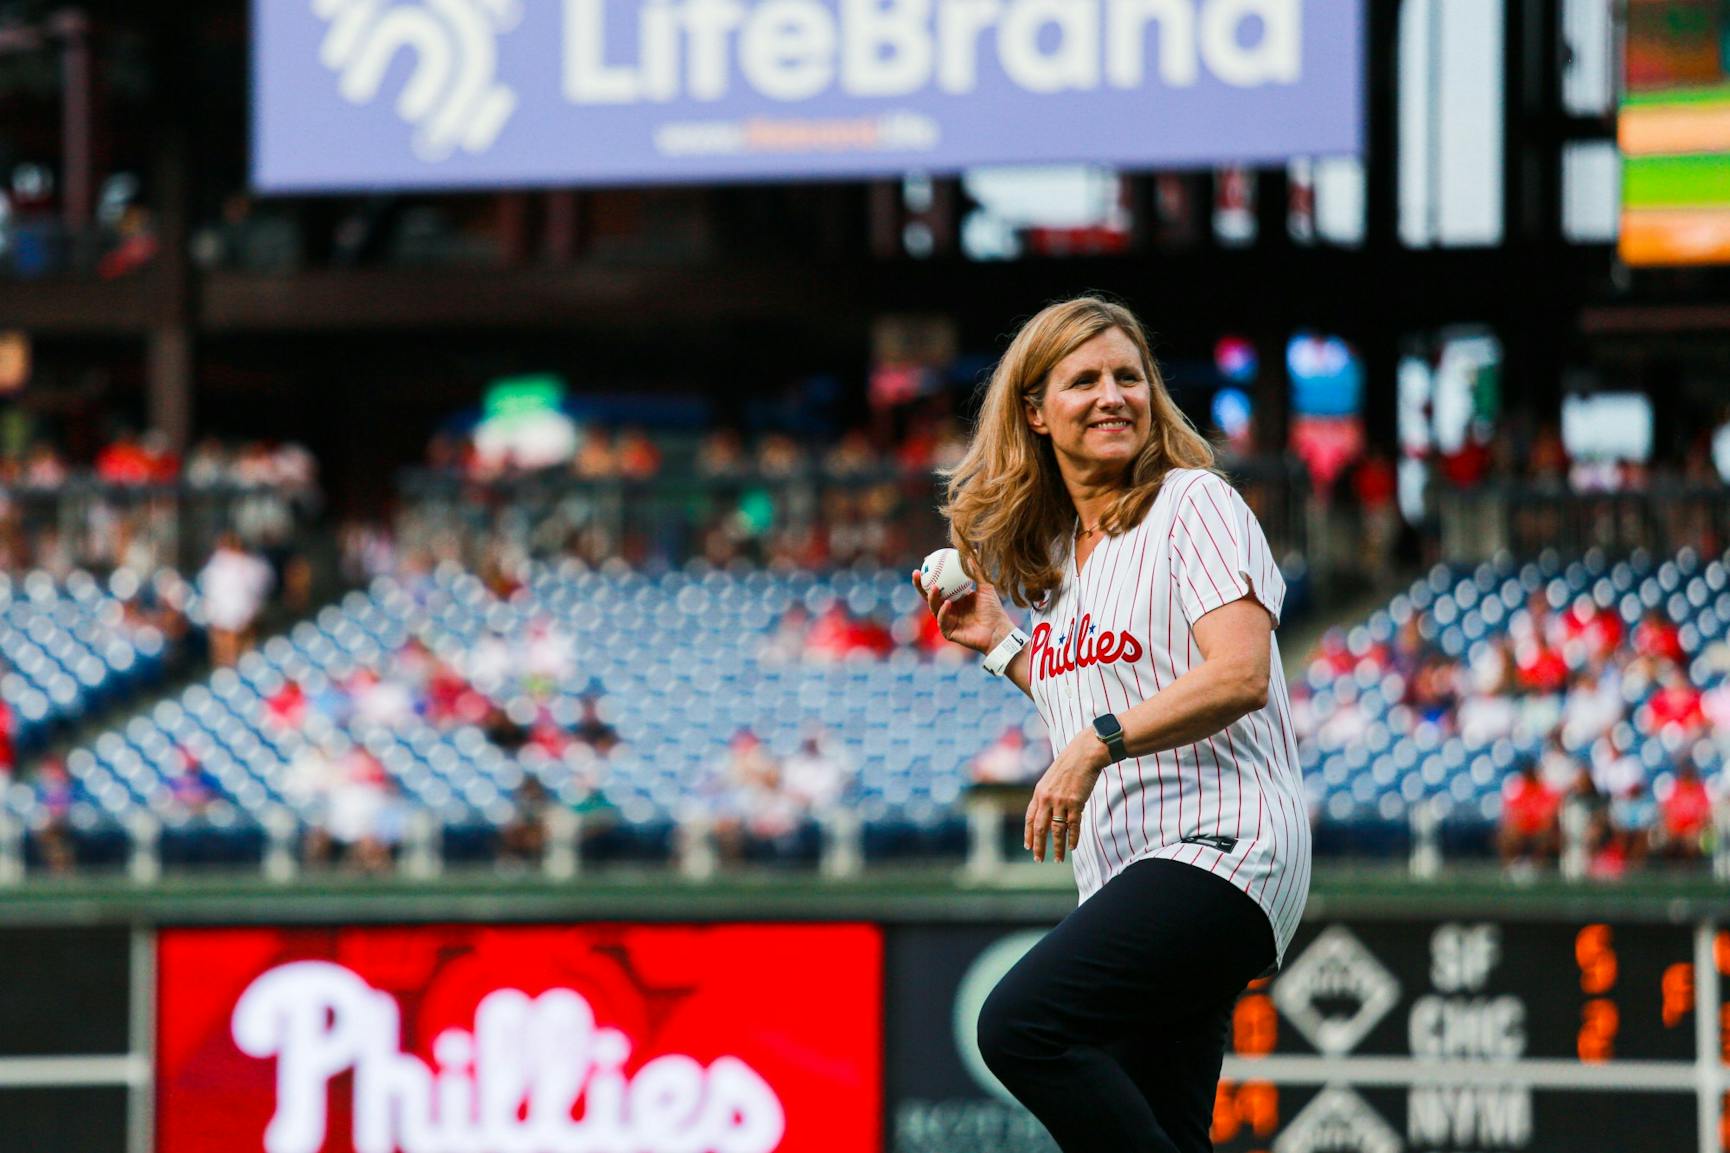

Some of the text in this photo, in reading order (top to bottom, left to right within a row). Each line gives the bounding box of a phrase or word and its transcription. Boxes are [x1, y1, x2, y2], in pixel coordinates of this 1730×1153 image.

[1029, 612, 1143, 687] Phillies
[1430, 924, 1499, 992] SF
[231, 959, 785, 1153] Phillies
